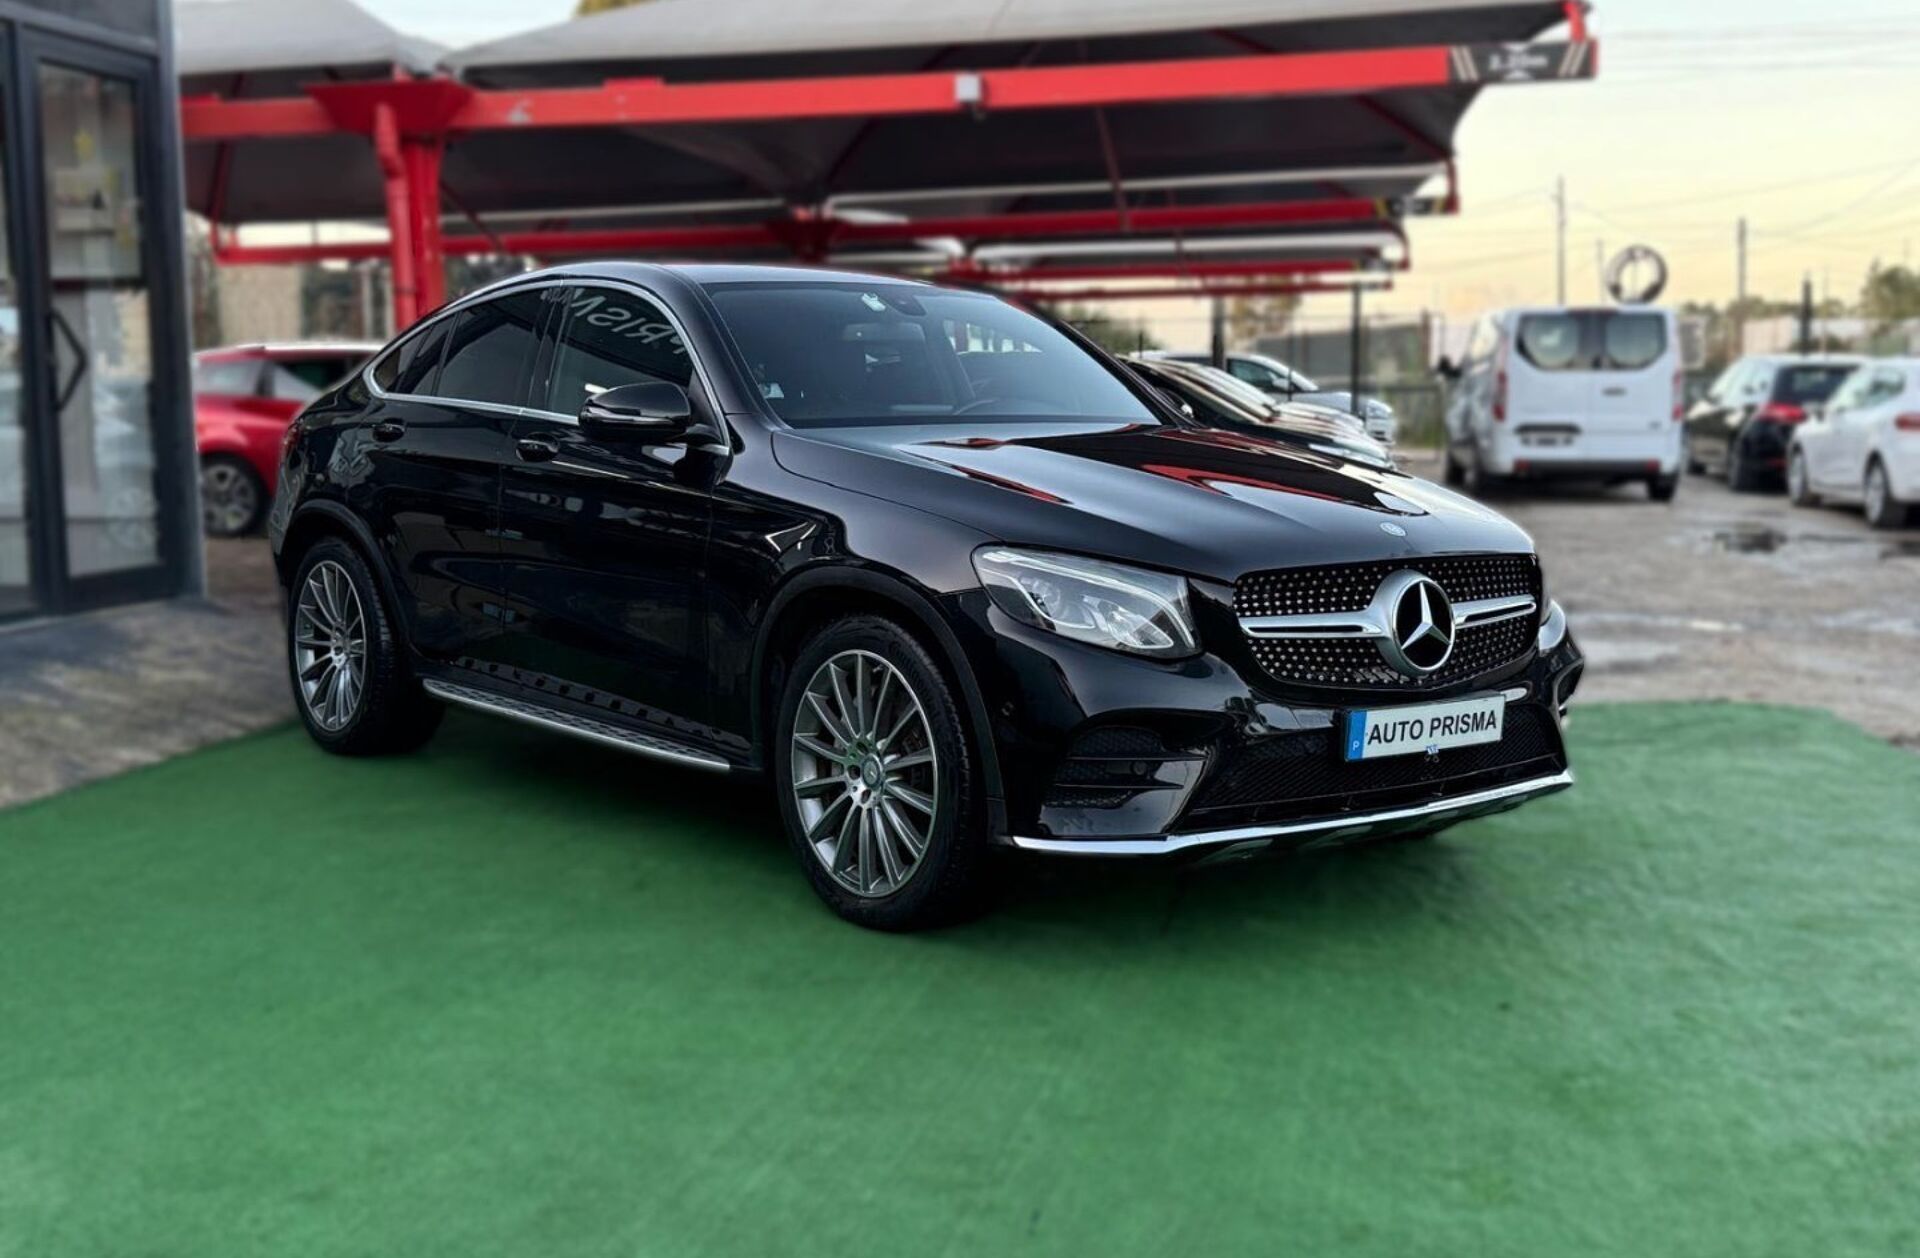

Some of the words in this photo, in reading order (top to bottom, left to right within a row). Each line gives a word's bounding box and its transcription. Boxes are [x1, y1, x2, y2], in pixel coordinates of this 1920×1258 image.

[1367, 719, 1424, 746] AUTO
[1429, 710, 1497, 738] PRISMA
[1352, 740, 1360, 751] P
